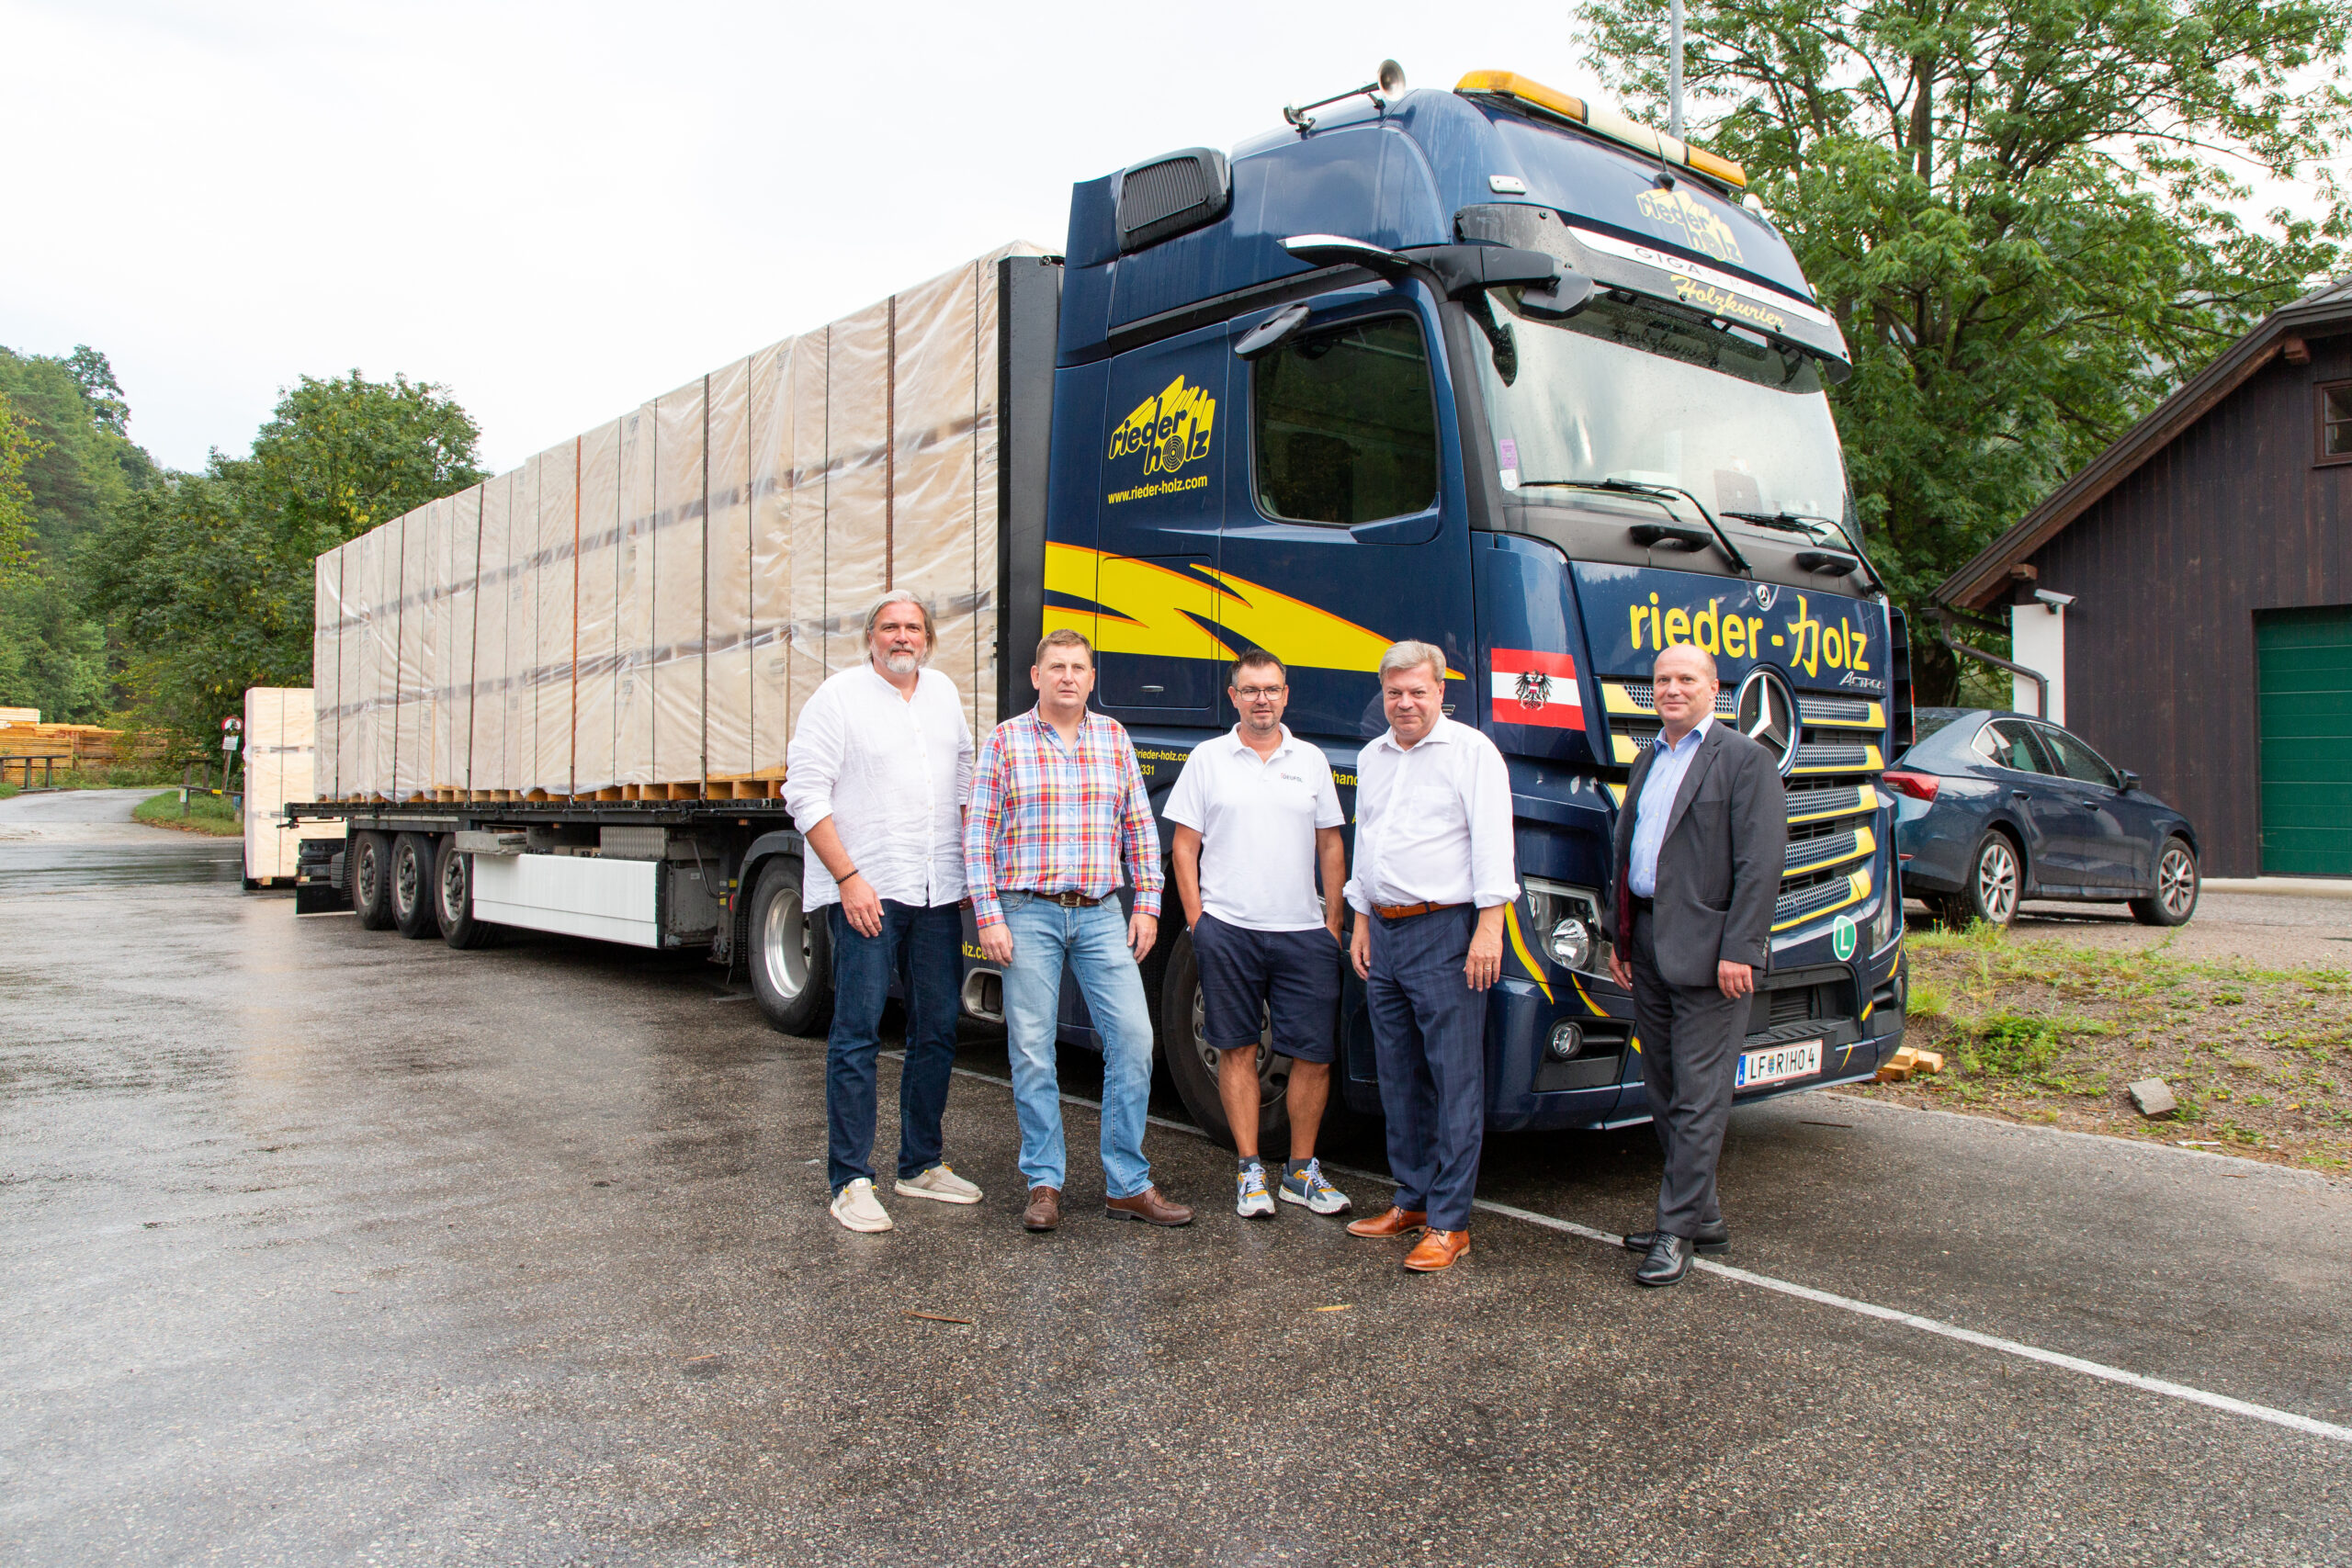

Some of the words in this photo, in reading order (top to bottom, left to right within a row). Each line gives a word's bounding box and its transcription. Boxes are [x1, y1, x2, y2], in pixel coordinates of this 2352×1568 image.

[1636, 188, 1711, 231] rieder
[1670, 275, 1785, 329] Holzkurier
[1109, 397, 1188, 459] rieder
[1144, 416, 1210, 475] holz
[1108, 475, 1208, 504] www.rieder-holz.com
[1839, 926, 1850, 951] L
[1750, 1055, 1766, 1079] LF
[1808, 1047, 1815, 1068] 4
